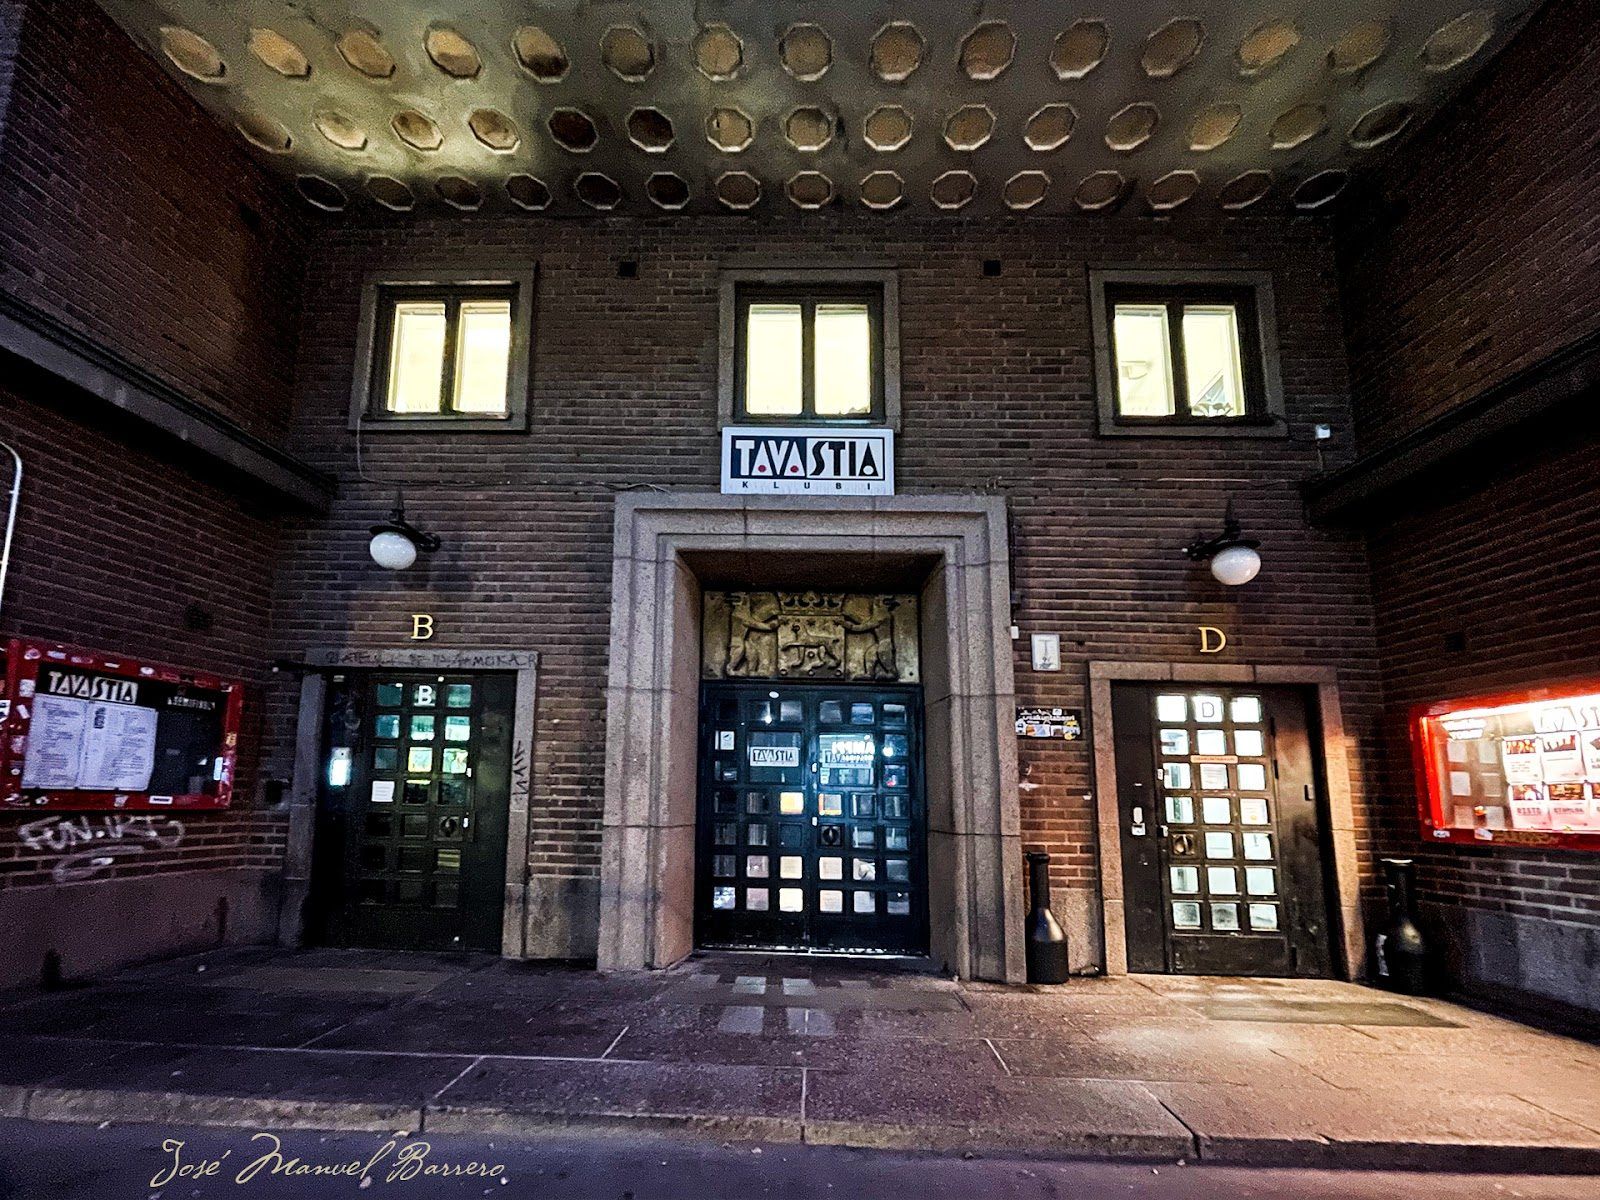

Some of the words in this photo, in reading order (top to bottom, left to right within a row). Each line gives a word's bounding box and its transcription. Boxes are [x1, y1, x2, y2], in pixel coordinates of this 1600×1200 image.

[735, 439, 879, 477] TAVASTIA
[410, 614, 434, 640] B
[1198, 626, 1227, 653] D
[48, 671, 138, 703] TAVASTIA
[417, 685, 433, 704] B
[1202, 701, 1215, 718] D
[753, 749, 794, 762] TAVASTIA
